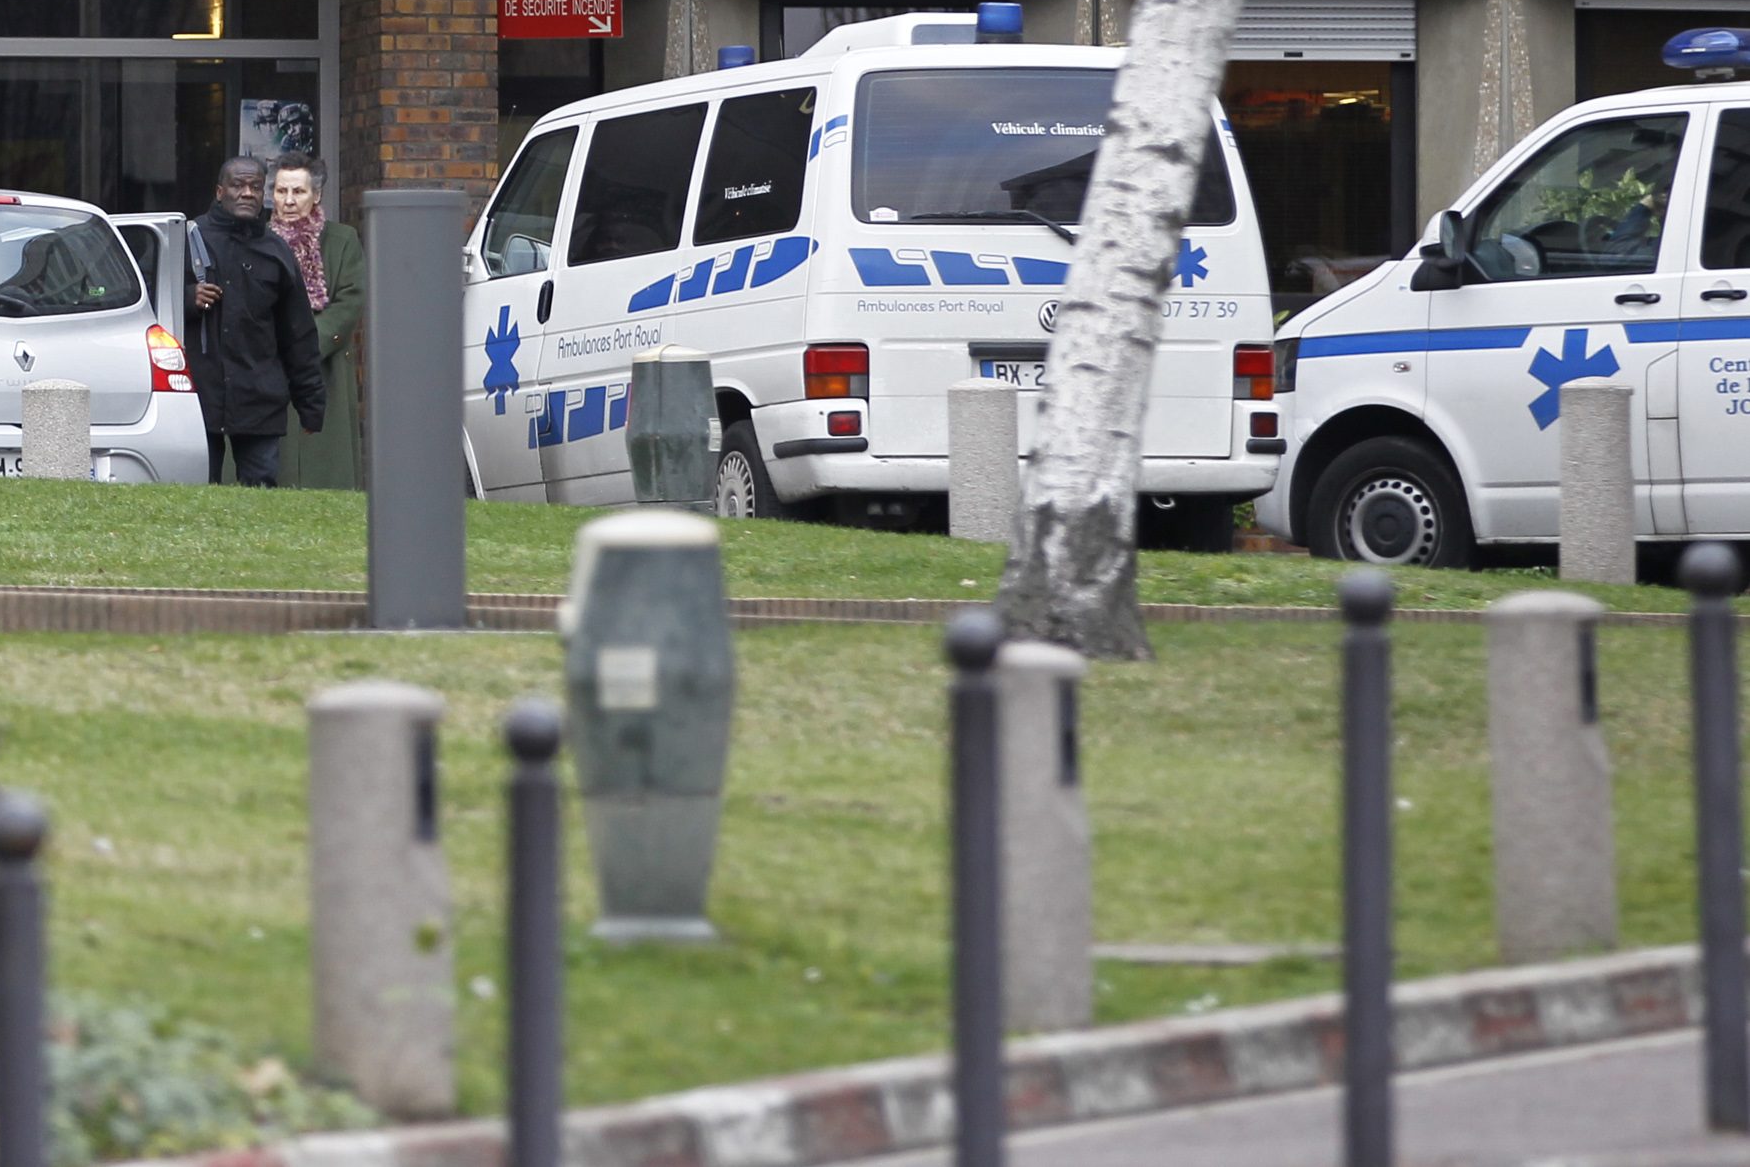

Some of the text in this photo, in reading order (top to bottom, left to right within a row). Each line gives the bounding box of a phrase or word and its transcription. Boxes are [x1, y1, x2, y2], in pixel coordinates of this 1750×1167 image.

[505, 0, 518, 16] DE
[991, 122, 1105, 137] Véhicule climatisé
[857, 299, 1004, 315] Ambulances Port Royal
[1161, 300, 1238, 318] 07 37 39
[557, 321, 663, 359] Ambulances Port Royal
[1709, 357, 1750, 373] Cen
[1716, 377, 1741, 394] de
